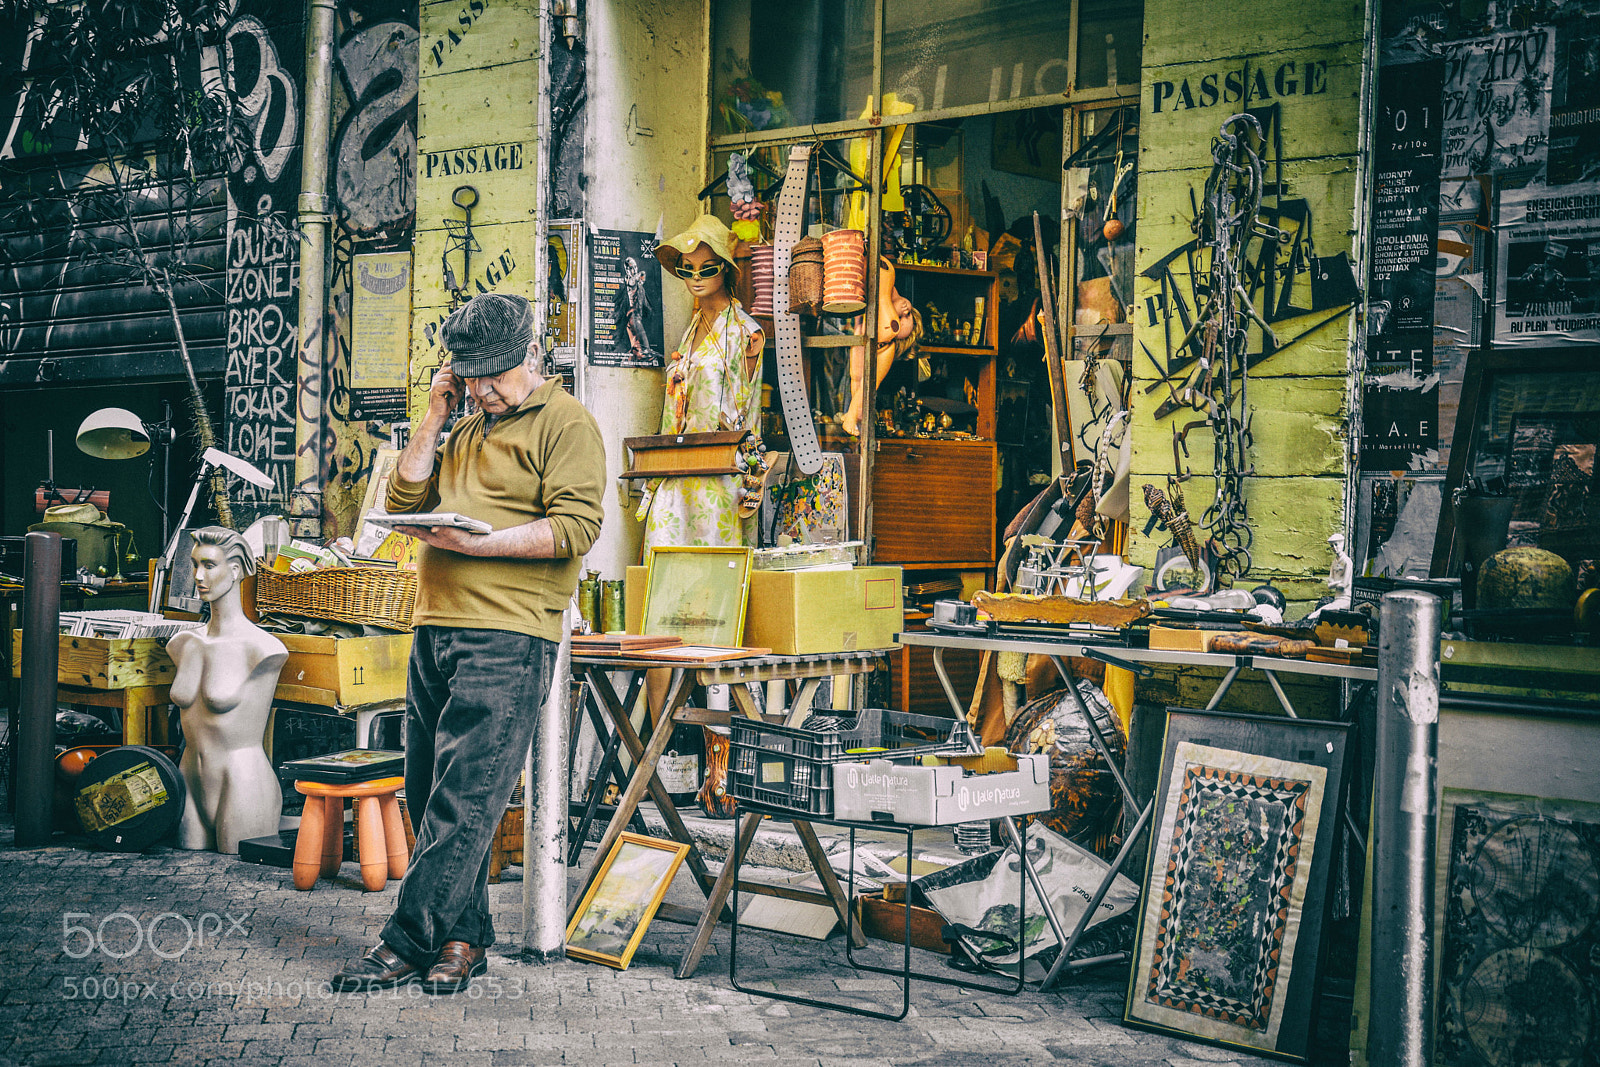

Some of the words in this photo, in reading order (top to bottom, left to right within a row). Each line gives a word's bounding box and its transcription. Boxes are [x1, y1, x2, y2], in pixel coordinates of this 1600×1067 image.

[430, 0, 489, 68] PASS
[1152, 60, 1328, 113] PASSAGE
[425, 144, 523, 178] PASSAGE
[1395, 208, 1412, 216] MAY
[1525, 212, 1538, 223] EN
[1376, 234, 1429, 245] APOLLONIA
[1375, 264, 1409, 272] MADNAX
[1548, 301, 1571, 314] NON
[1511, 322, 1522, 333] AU
[1525, 320, 1547, 332] PLAN
[226, 386, 295, 425] TOKAR
